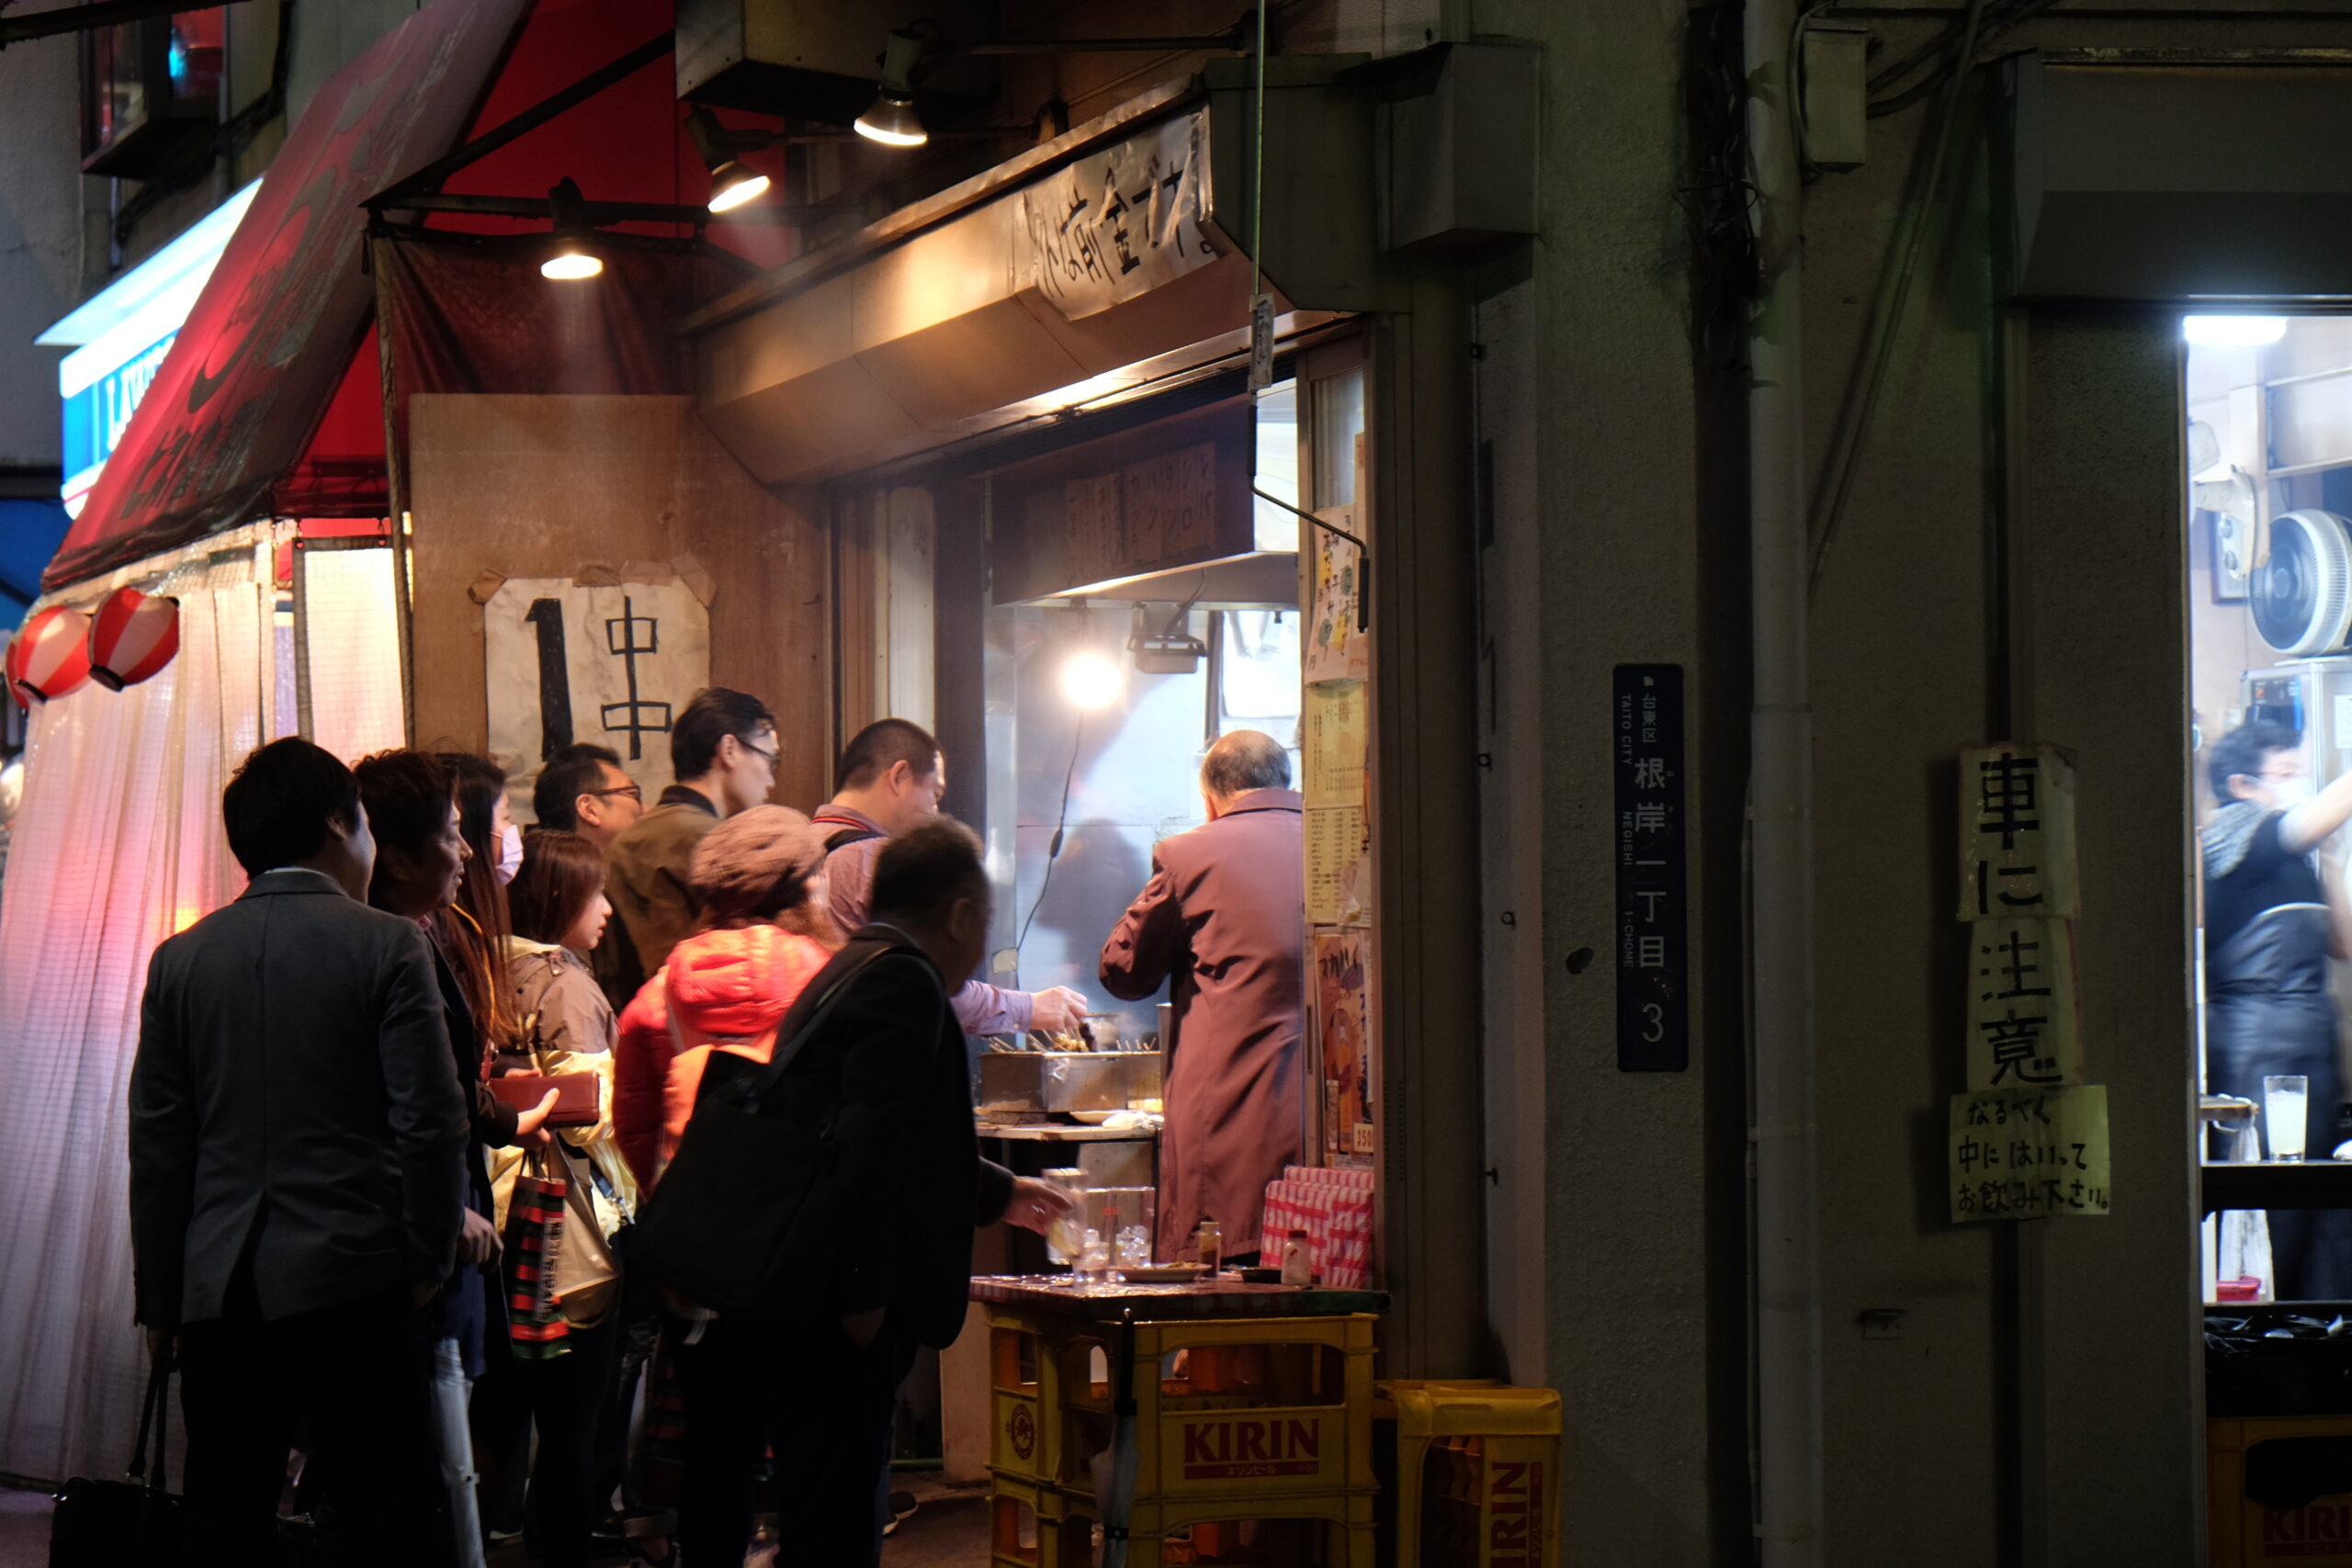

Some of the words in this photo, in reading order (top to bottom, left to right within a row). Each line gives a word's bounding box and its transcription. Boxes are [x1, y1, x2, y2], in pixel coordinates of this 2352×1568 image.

[1621, 693, 1633, 730] TAITO
[1641, 693, 1658, 744] 台東区
[1621, 735, 1633, 765] CITY
[1622, 810, 1634, 866] NEGISHI
[1634, 757, 1668, 968] 根岸一丁目
[1623, 911, 1635, 969] 1-CHOME
[1977, 752, 2064, 1087] 車に注意
[1641, 1003, 1665, 1043] 3
[1967, 1094, 2051, 1126] なるべく
[1183, 1419, 1320, 1464] KIRIN
[1227, 1465, 1279, 1477] キリンビール
